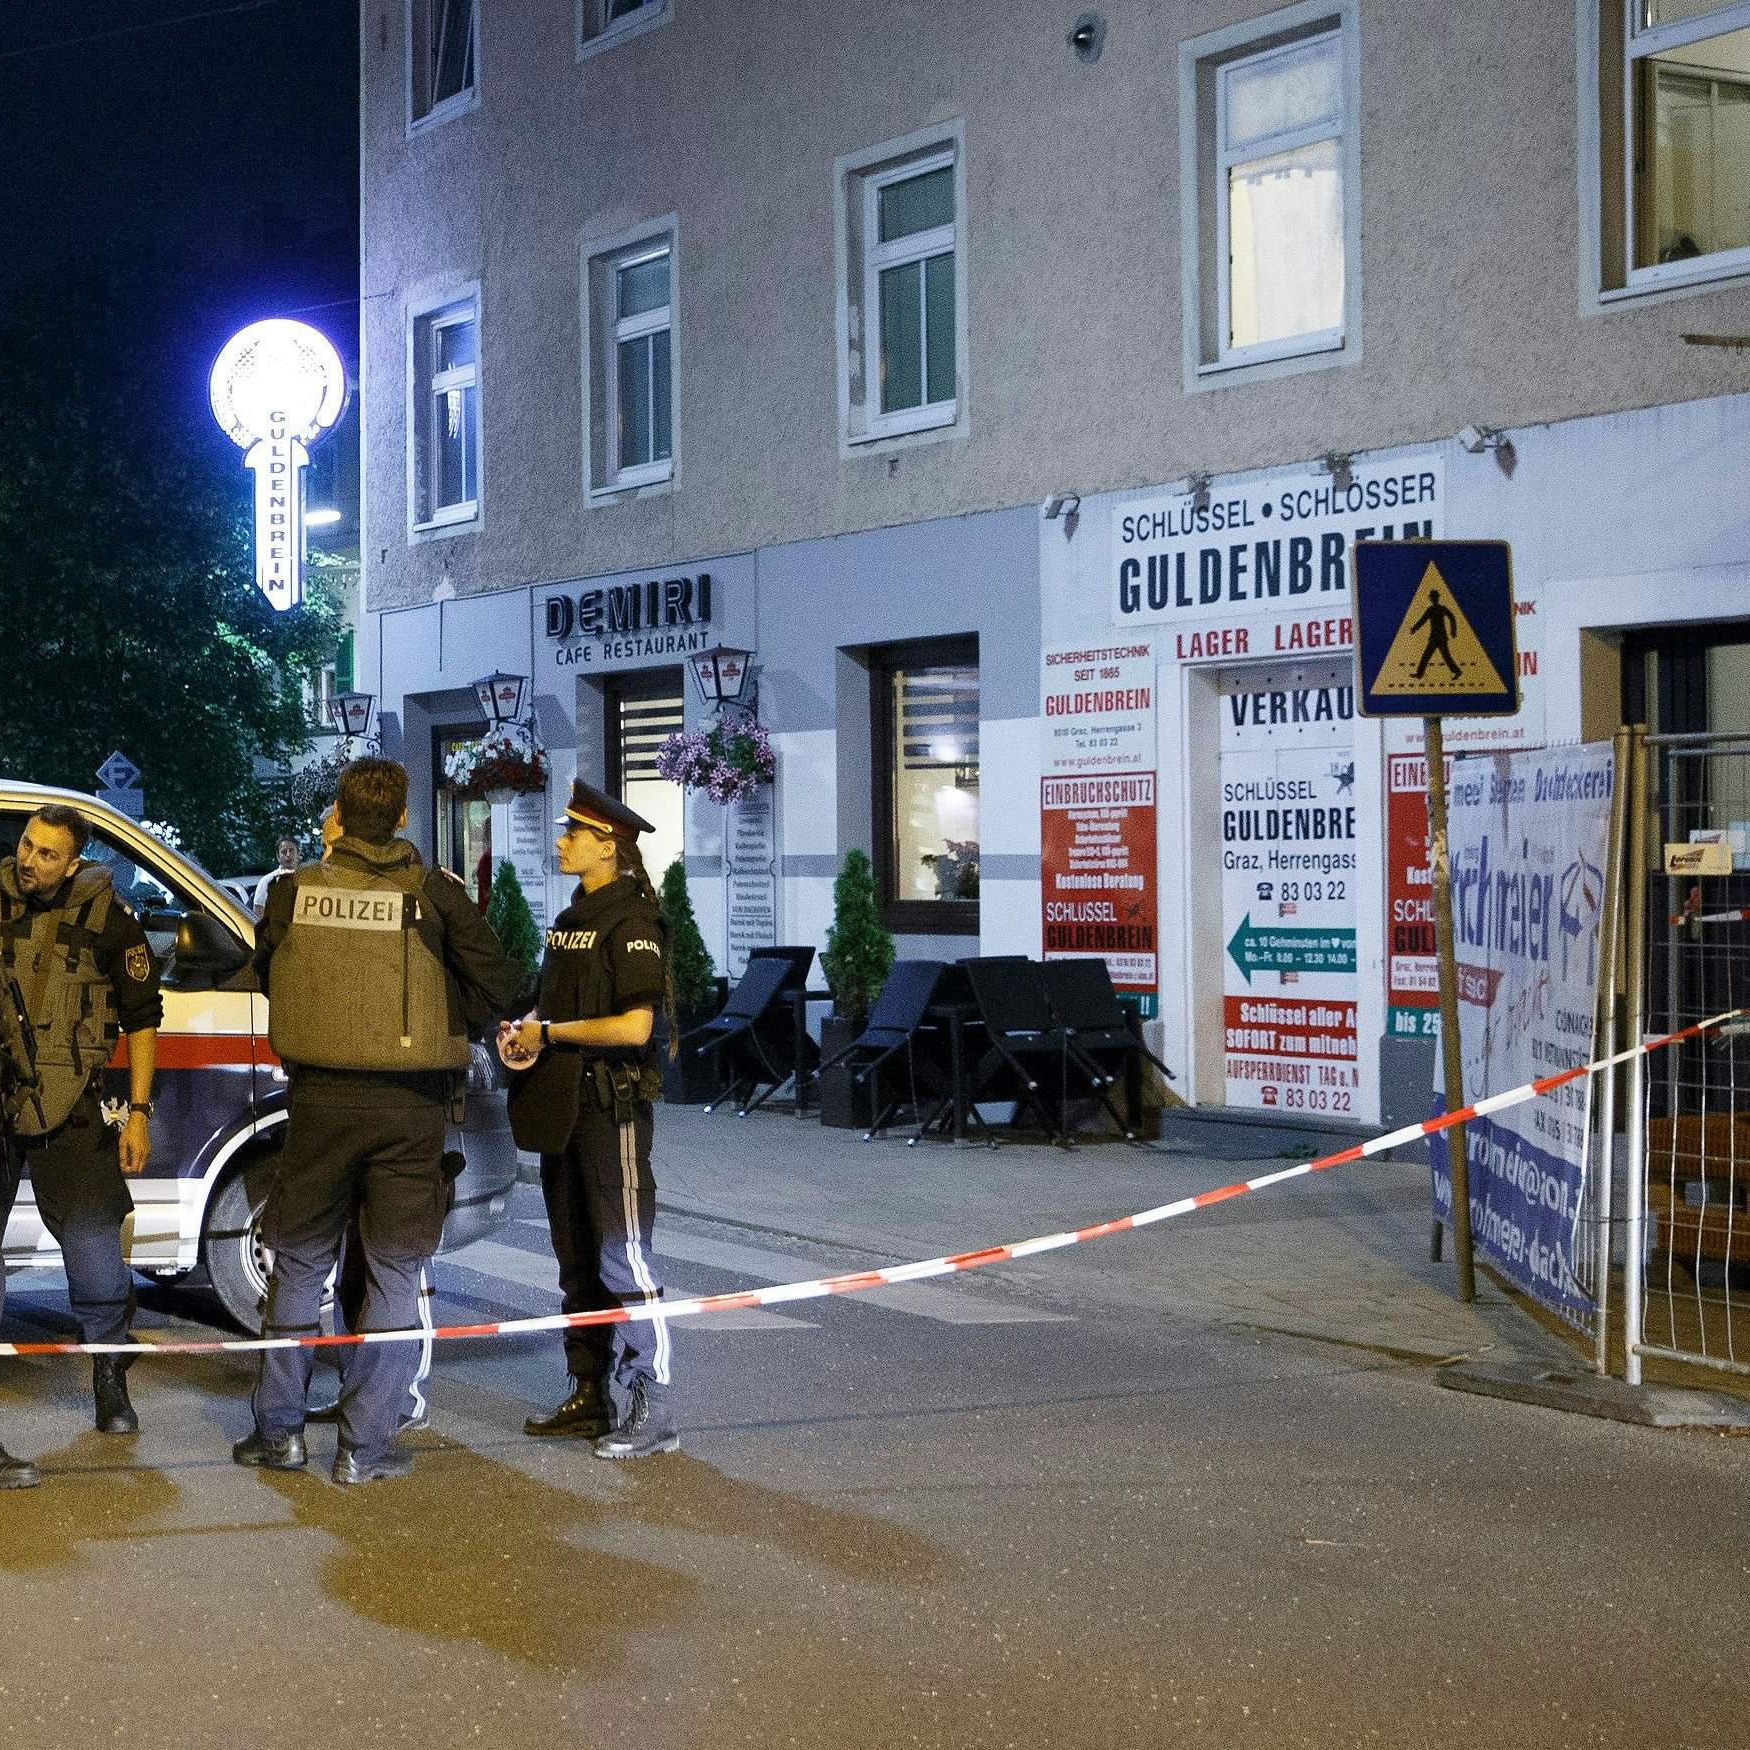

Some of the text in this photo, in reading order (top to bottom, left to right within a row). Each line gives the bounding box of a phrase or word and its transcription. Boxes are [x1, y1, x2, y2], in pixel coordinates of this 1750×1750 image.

[268, 410, 288, 592] GULDENBREIN
[1121, 472, 1436, 544] SCHLÜSSEL SCHLÖSSER
[1118, 520, 1434, 613] GULDENBR
[545, 573, 712, 640] DEMIRI
[555, 631, 709, 666] CAFE RESTAURANT
[1176, 618, 1354, 660] LAGER LAGER
[1046, 644, 1150, 666] SICHERHEITSTECHNIK
[1074, 668, 1095, 681] SEIT
[1045, 687, 1150, 716] GULDENBREIN
[1045, 779, 1151, 805] EINBRUCHSCHUTZ
[1224, 777, 1317, 801] SCHLÜSSEL
[1224, 851, 1264, 873] Graz,
[1281, 880, 1346, 901] 83 03 22
[302, 895, 393, 921] POLIZEI
[546, 929, 597, 950] POLIZEI
[1047, 924, 1152, 949] GULDENBREIN
[1240, 1002, 1306, 1026] Schlüssel
[1309, 1006, 1343, 1028] aller
[1395, 1011, 1417, 1033] bis
[1226, 1028, 1277, 1051] SOFORT
[1280, 1035, 1306, 1052] zum
[1226, 1059, 1311, 1085] AUFSPERRDIENST
[1318, 1065, 1337, 1086] TAG
[1286, 1087, 1351, 1112] 83 03 22
